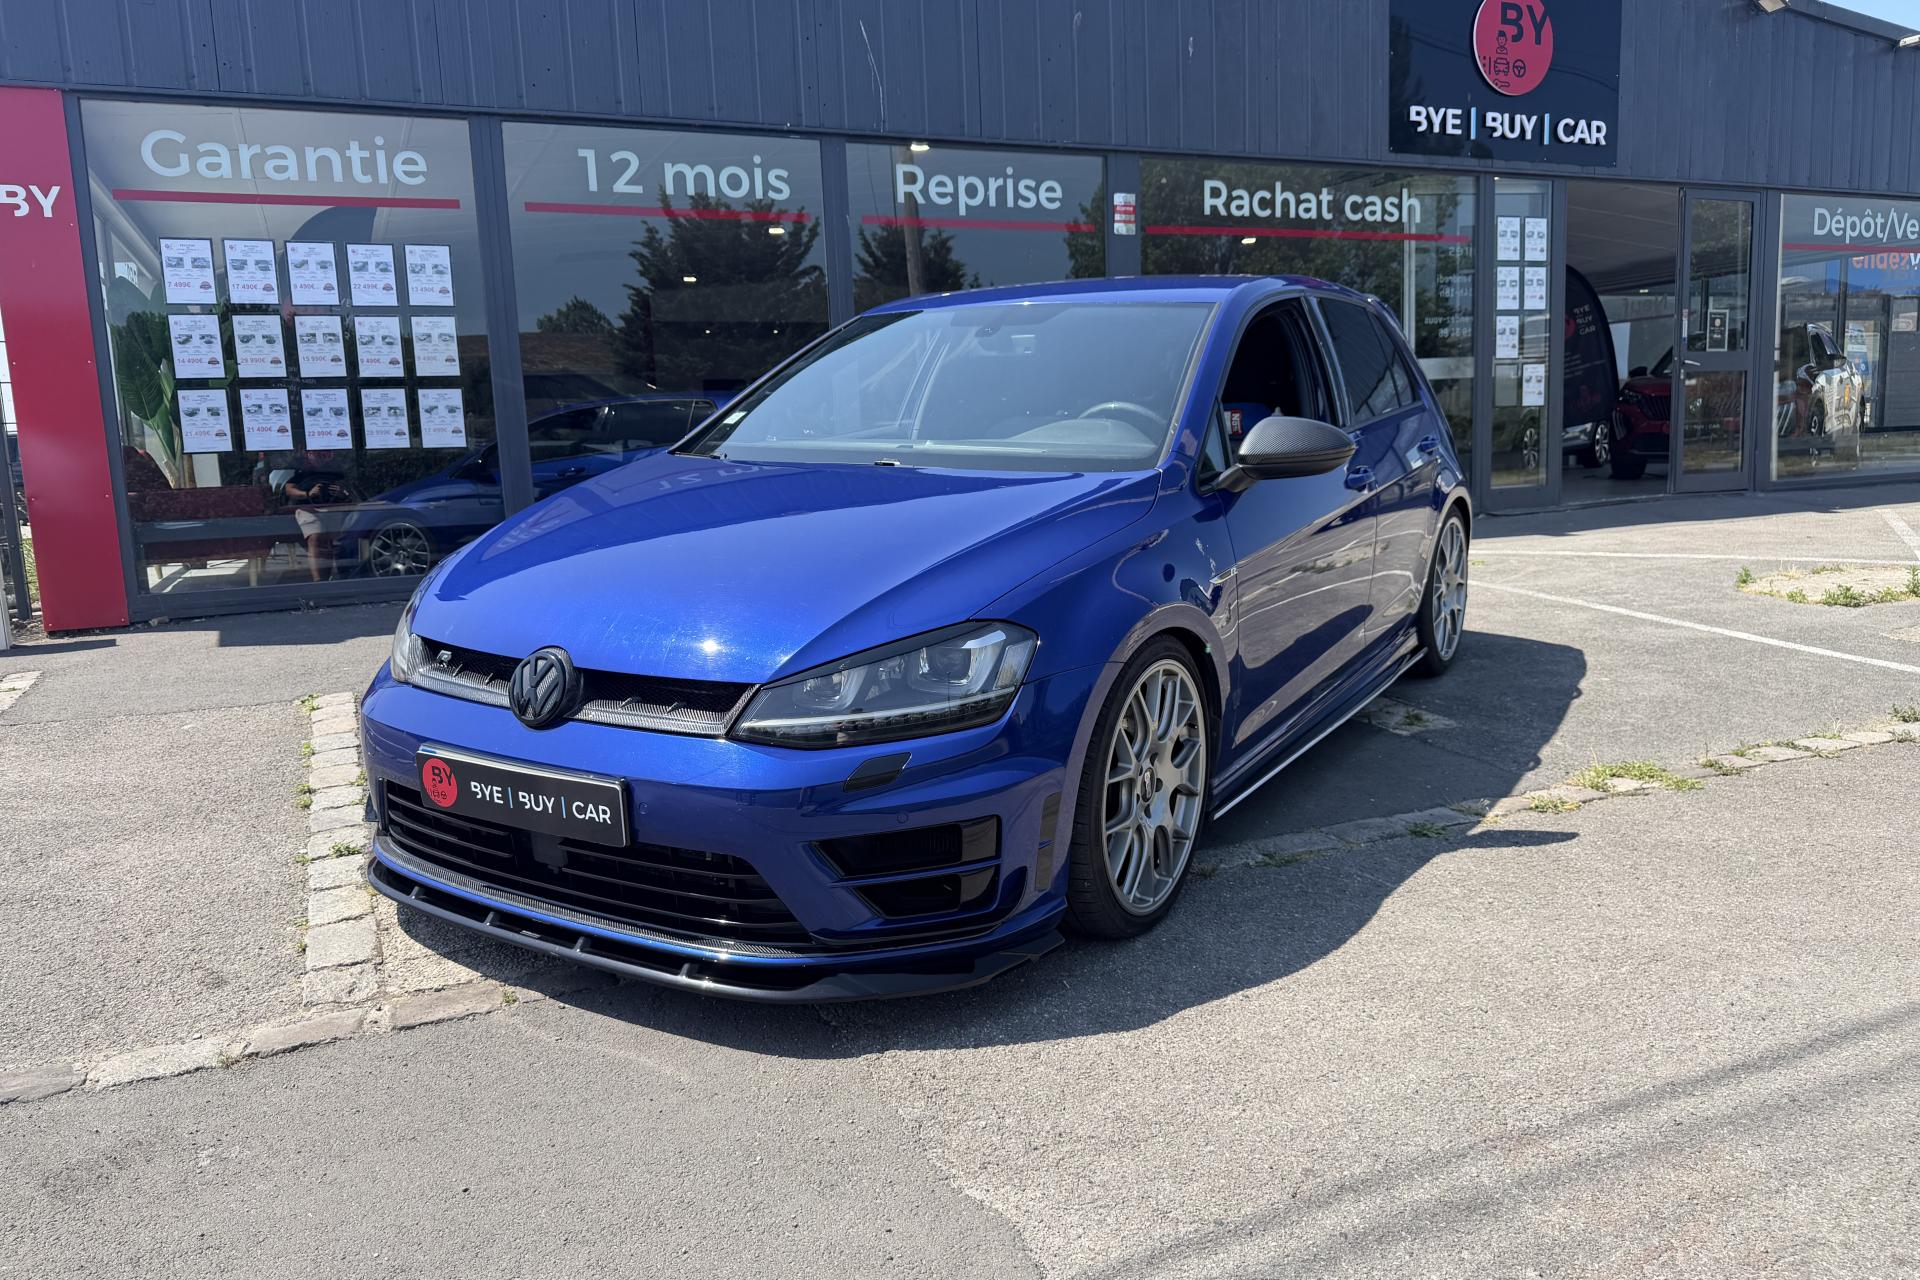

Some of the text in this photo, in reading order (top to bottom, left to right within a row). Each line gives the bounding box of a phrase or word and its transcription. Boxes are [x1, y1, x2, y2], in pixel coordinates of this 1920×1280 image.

[1501, 2, 1550, 45] BY
[1409, 105, 1607, 145] BYE BUY CAR
[140, 129, 428, 185] Garantie
[577, 148, 791, 201] 12 mois
[0, 184, 61, 218] BY
[895, 163, 1063, 216] Reprise
[1203, 179, 1421, 224] Rachat cash
[431, 765, 454, 786] BY
[470, 780, 611, 824] BYE BUY CAR
